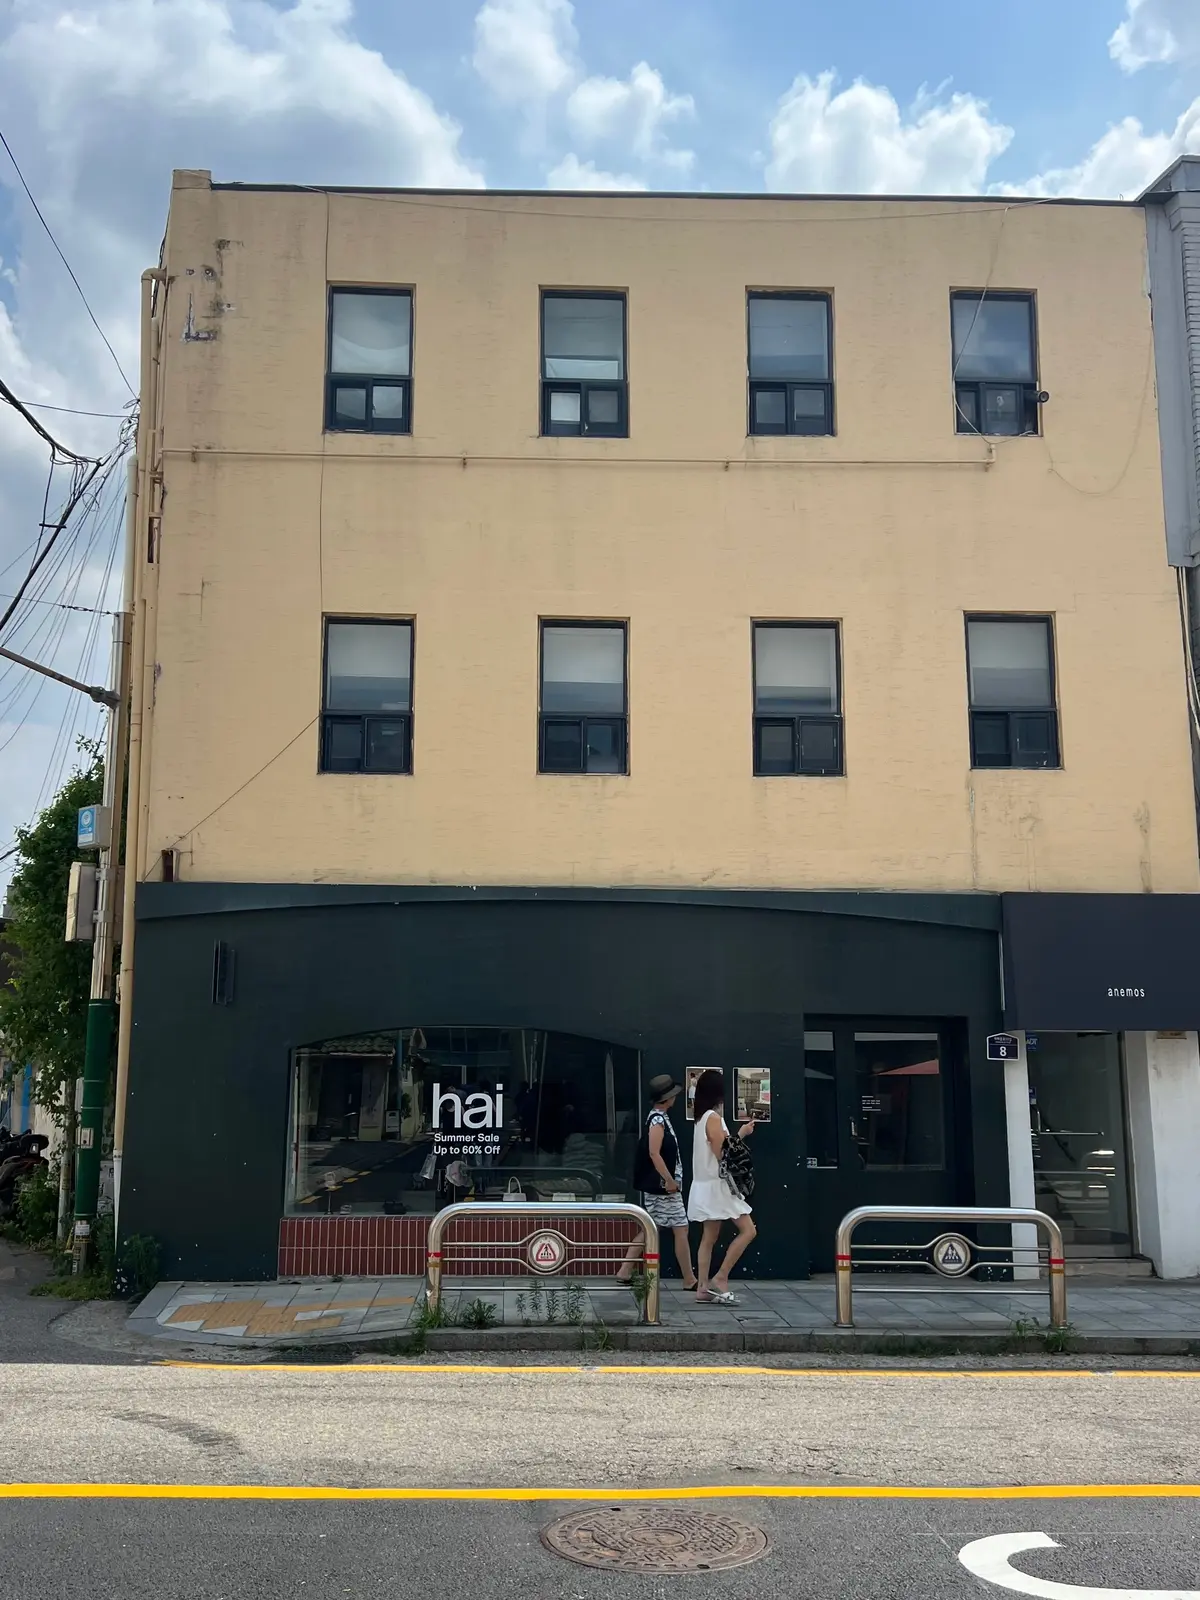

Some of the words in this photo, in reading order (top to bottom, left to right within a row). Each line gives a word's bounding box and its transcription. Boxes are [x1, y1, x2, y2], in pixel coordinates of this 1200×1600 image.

[1107, 987, 1145, 998] anemos
[999, 1046, 1007, 1057] 8
[432, 1083, 503, 1129] hai
[434, 1133, 476, 1142] Summer
[477, 1133, 500, 1142] Sale
[433, 1145, 448, 1156] Up
[450, 1146, 460, 1155] to
[462, 1145, 483, 1155] 60%
[484, 1145, 501, 1155] Off
